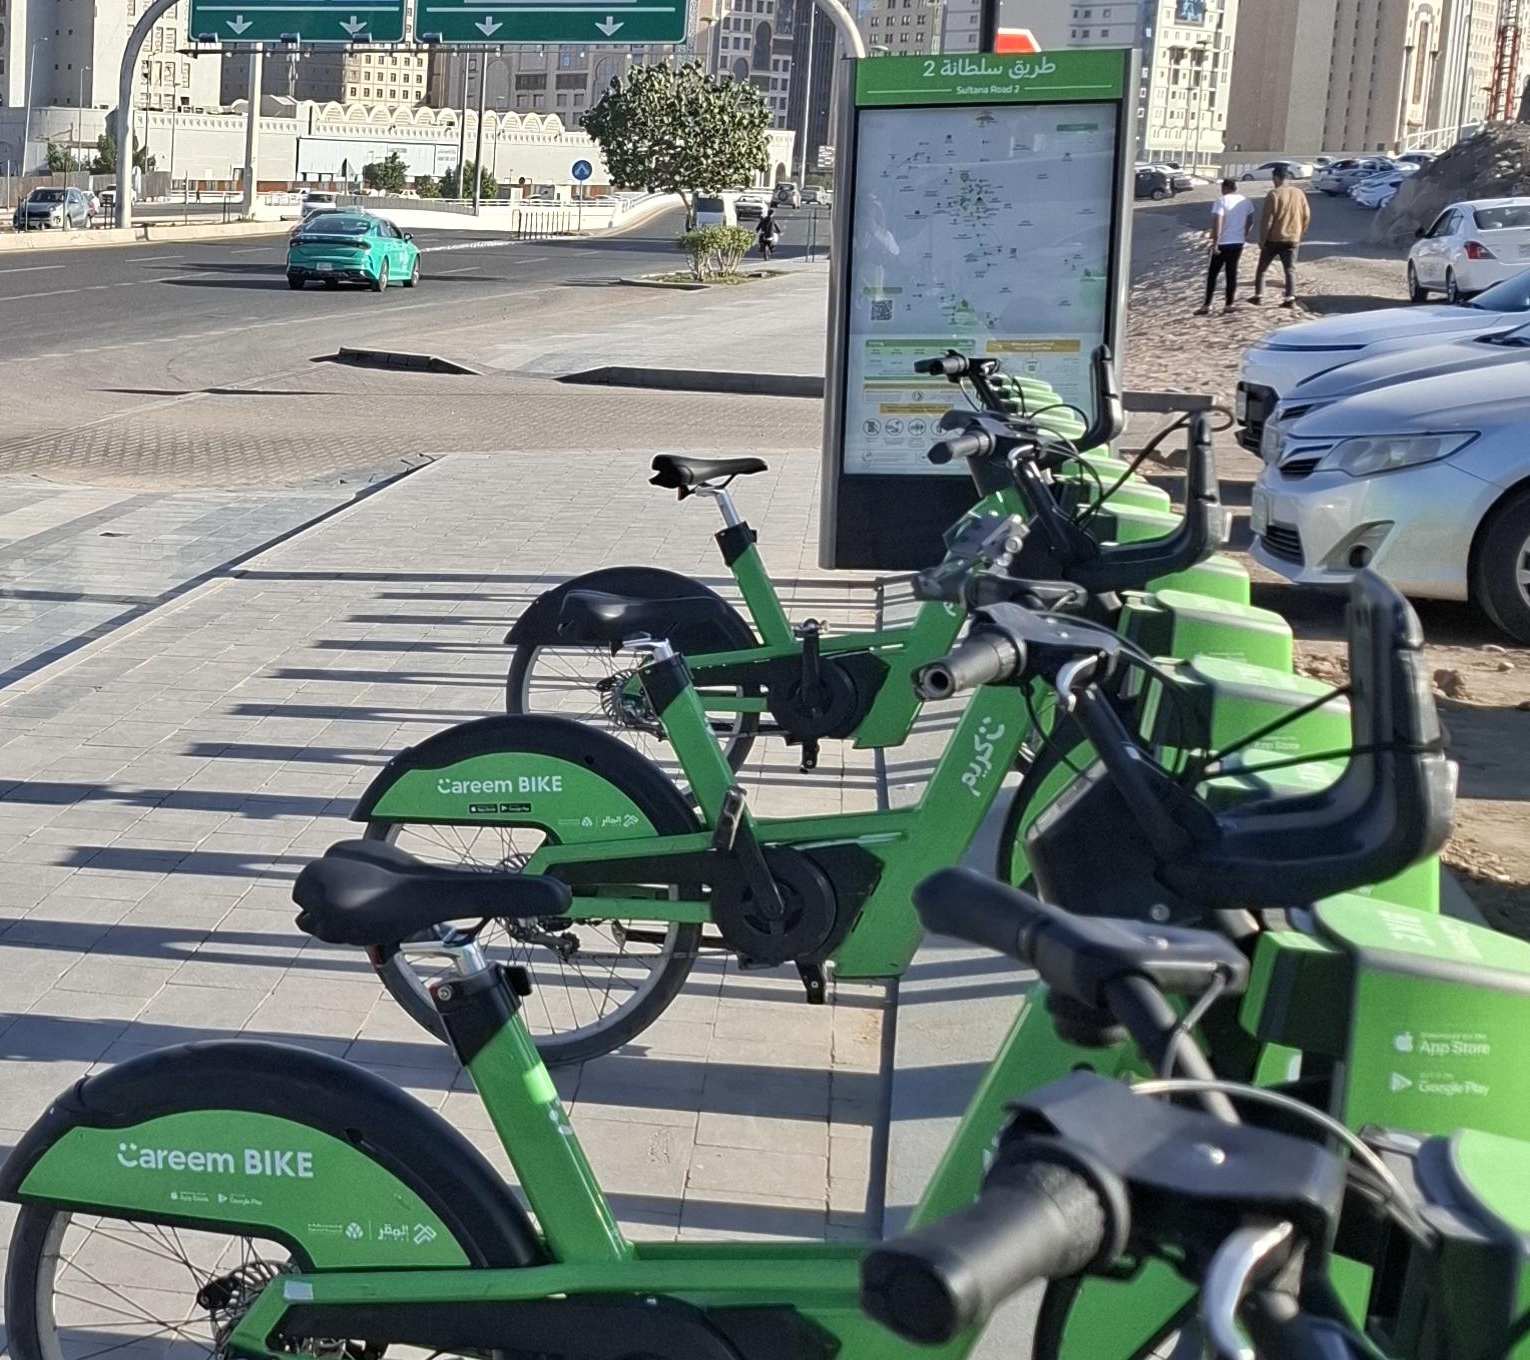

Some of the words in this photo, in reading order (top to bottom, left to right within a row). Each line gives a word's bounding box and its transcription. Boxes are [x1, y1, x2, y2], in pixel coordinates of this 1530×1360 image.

[923, 60, 935, 77] 2
[940, 58, 1003, 76] سلطانة
[1008, 56, 1056, 79] طريق
[956, 86, 989, 95] Sultana
[990, 85, 1013, 94] Road
[1014, 85, 1020, 93] 2
[437, 777, 512, 794] Careem
[518, 776, 562, 793] BIKE
[1420, 1040, 1450, 1056] App
[1451, 1040, 1490, 1055] Store
[1418, 1080, 1464, 1096] Google
[1465, 1080, 1489, 1097] Play
[118, 1142, 235, 1174] Careem
[244, 1149, 314, 1178] BIKE
[378, 1223, 409, 1240] المقر
